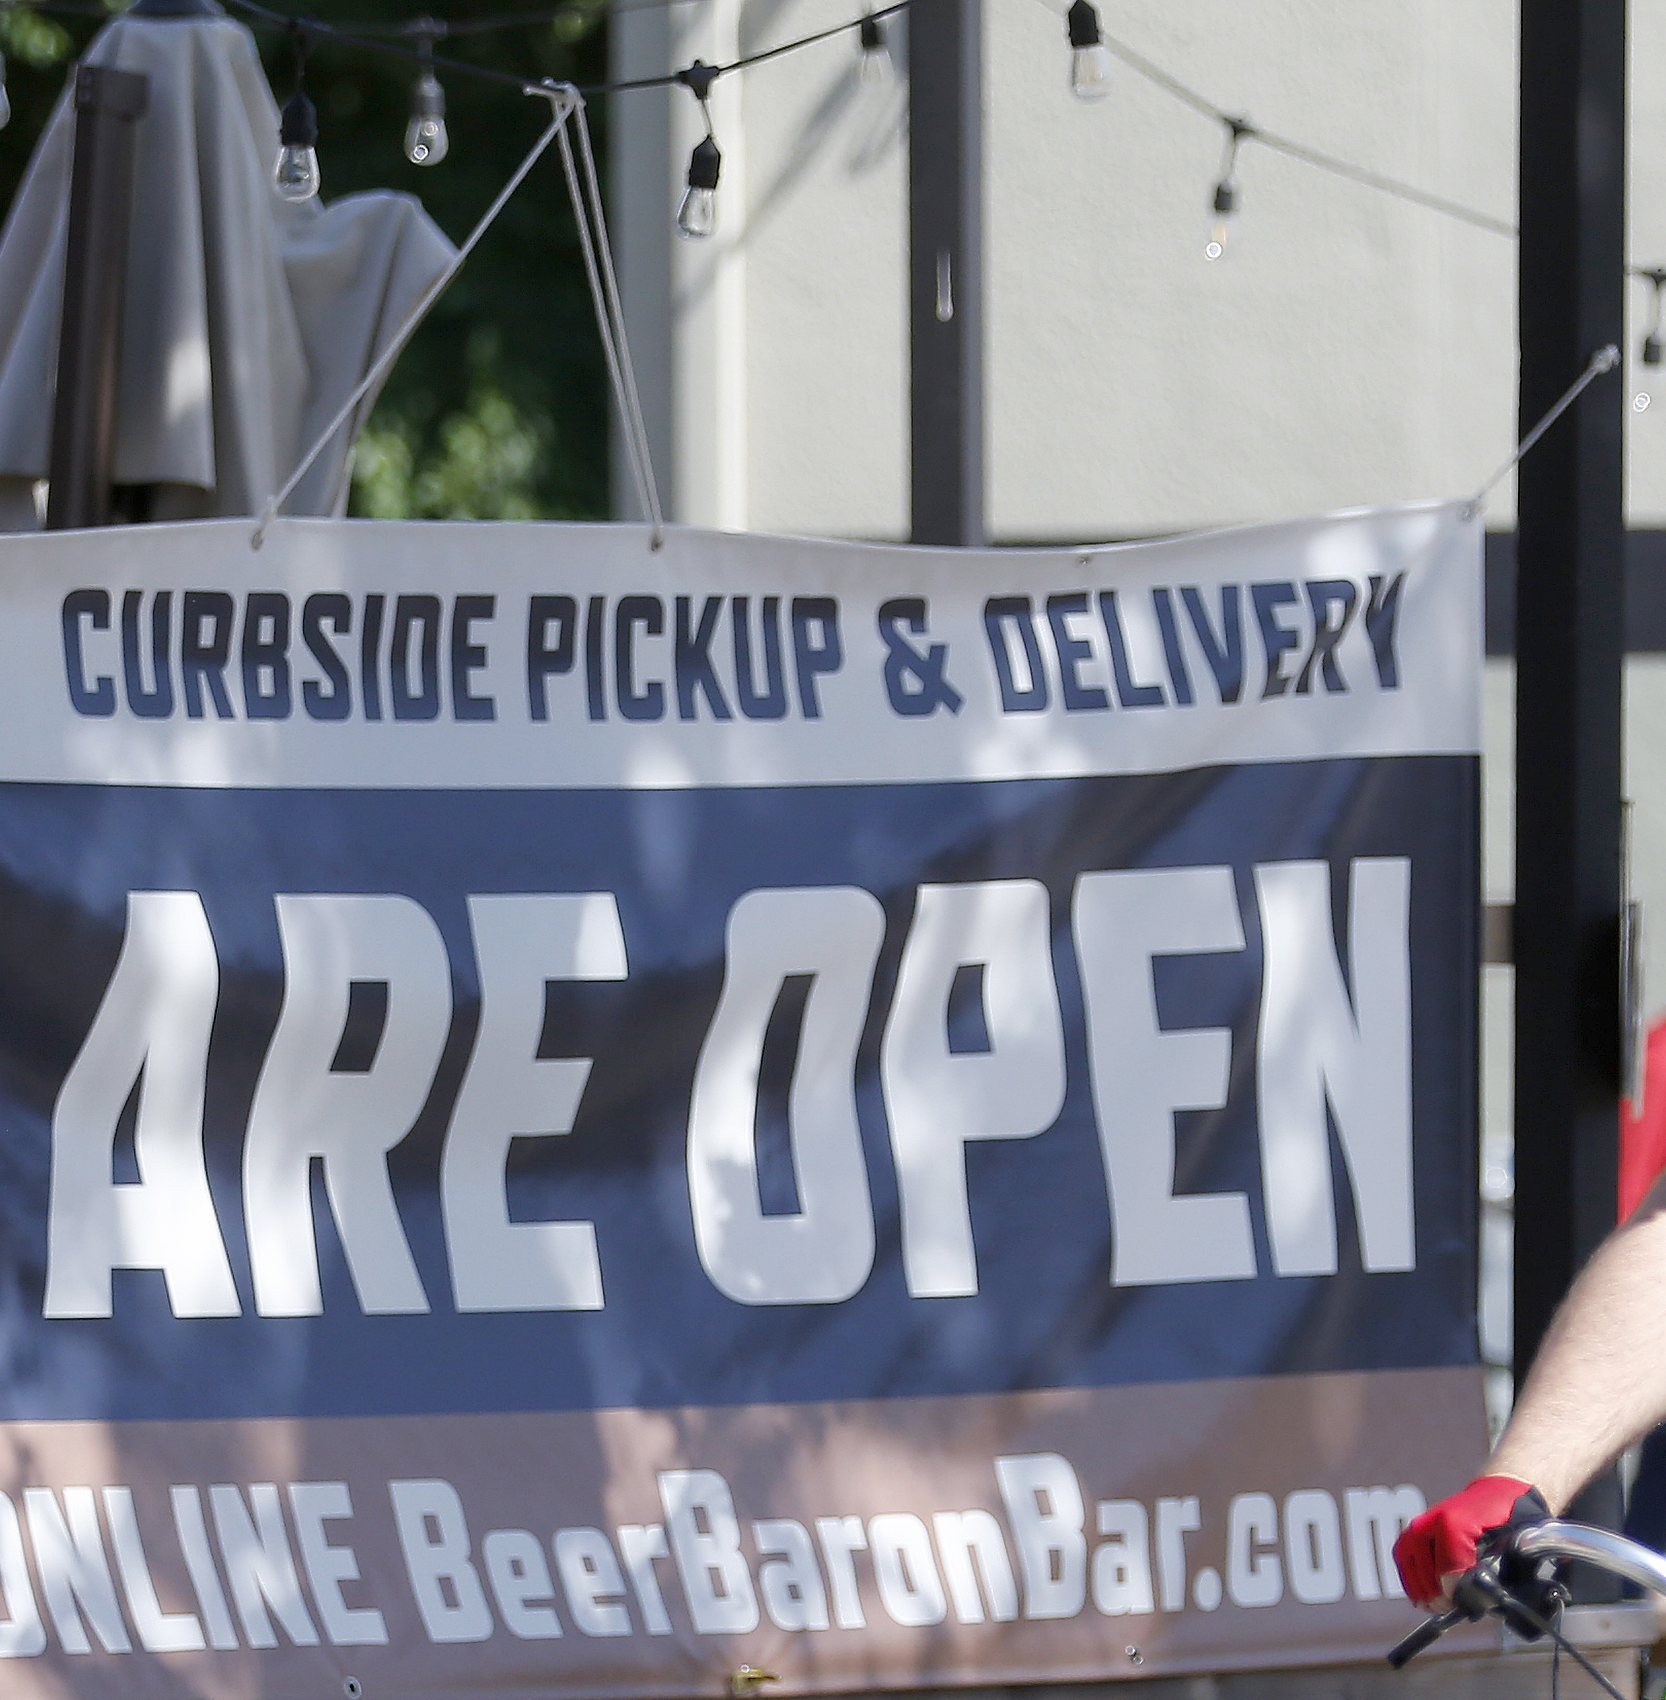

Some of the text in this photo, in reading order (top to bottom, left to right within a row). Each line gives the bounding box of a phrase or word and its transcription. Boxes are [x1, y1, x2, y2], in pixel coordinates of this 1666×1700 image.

[61, 571, 1407, 725] CURBSIDE PICKUP & DELIVERY
[41, 888, 630, 1320] ARE
[686, 855, 1418, 1308] OPEN
[390, 1452, 1427, 1645] BeerBaronBar.com
